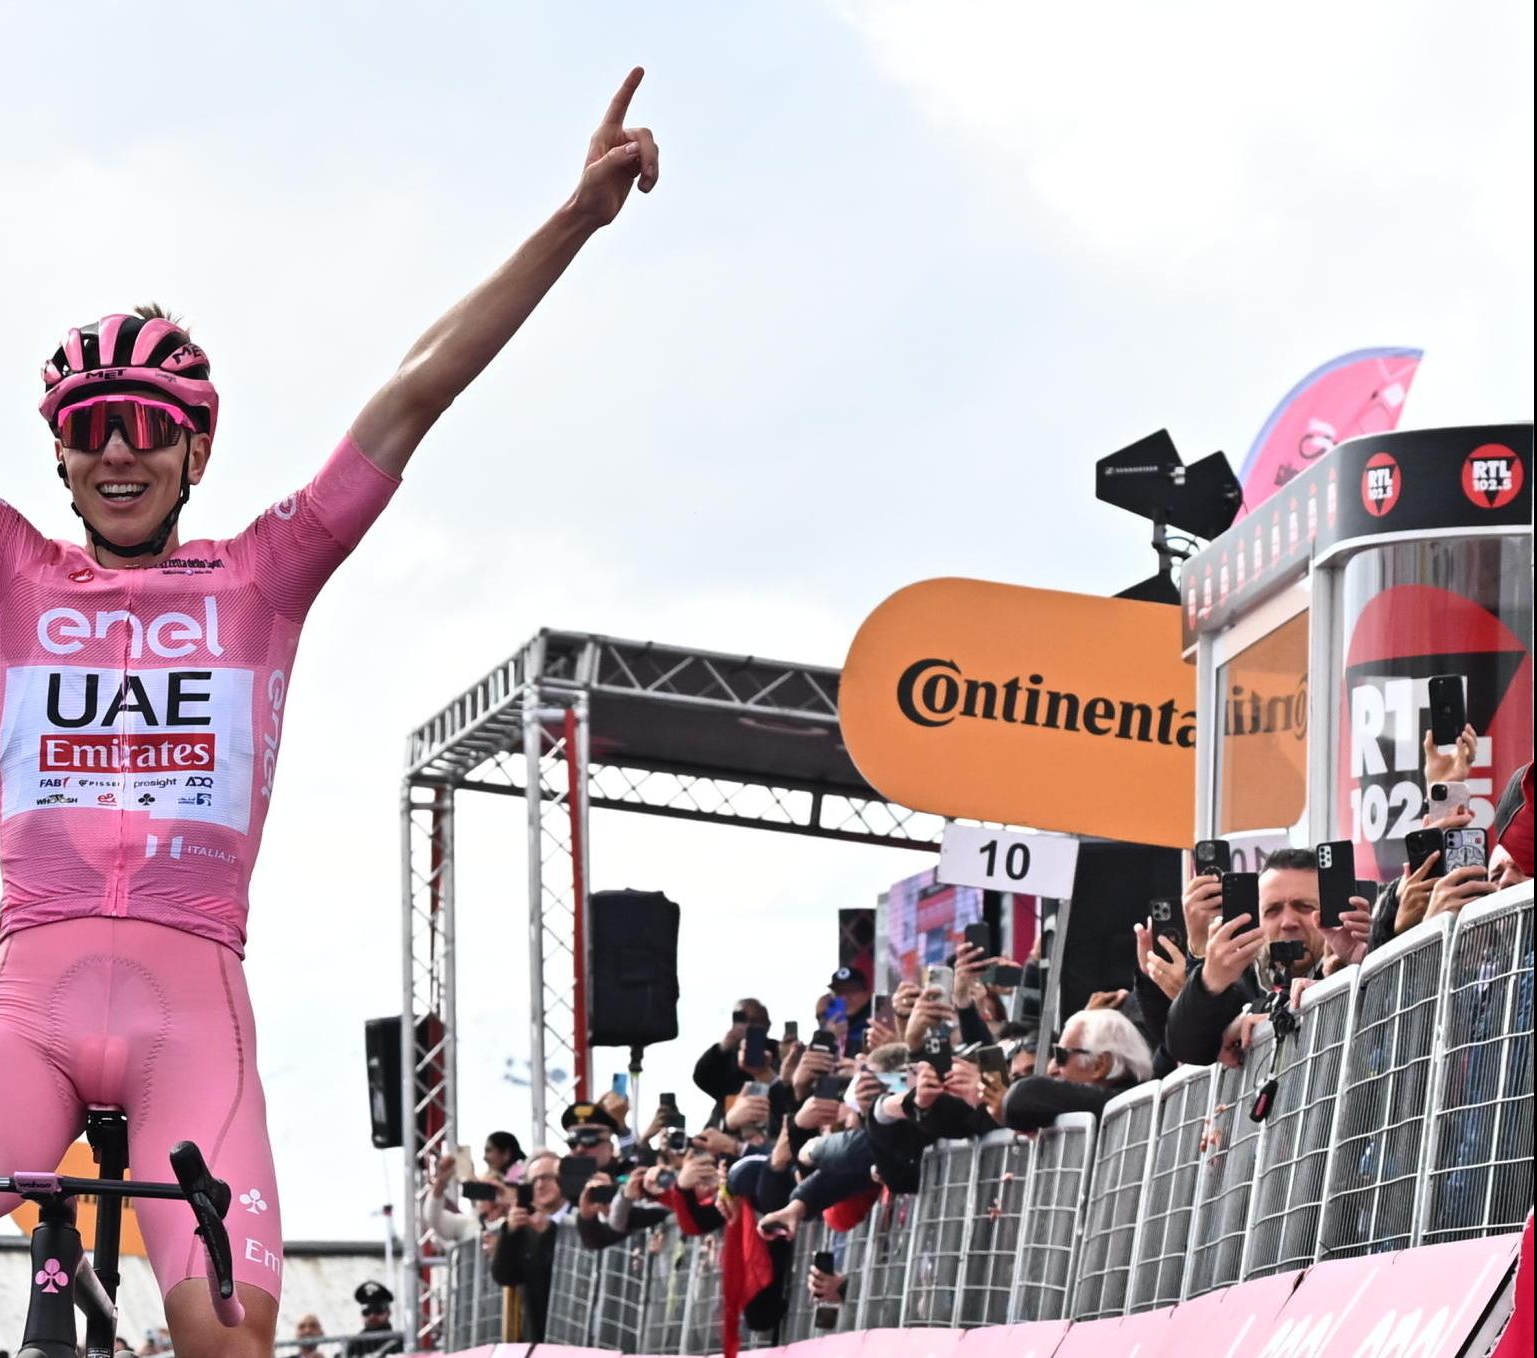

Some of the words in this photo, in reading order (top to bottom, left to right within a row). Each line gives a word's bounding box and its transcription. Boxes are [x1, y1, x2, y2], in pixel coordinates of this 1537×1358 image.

[85, 369, 127, 380] MET
[1367, 468, 1392, 487] RTL
[1472, 459, 1512, 478] RTL
[1472, 478, 1512, 491] 102.5
[36, 596, 225, 659] enel
[46, 671, 213, 729] UAE
[45, 736, 211, 769] Emirates
[133, 777, 178, 789] prosight
[187, 845, 238, 864] ITALIA.IT
[978, 839, 1032, 882] 10
